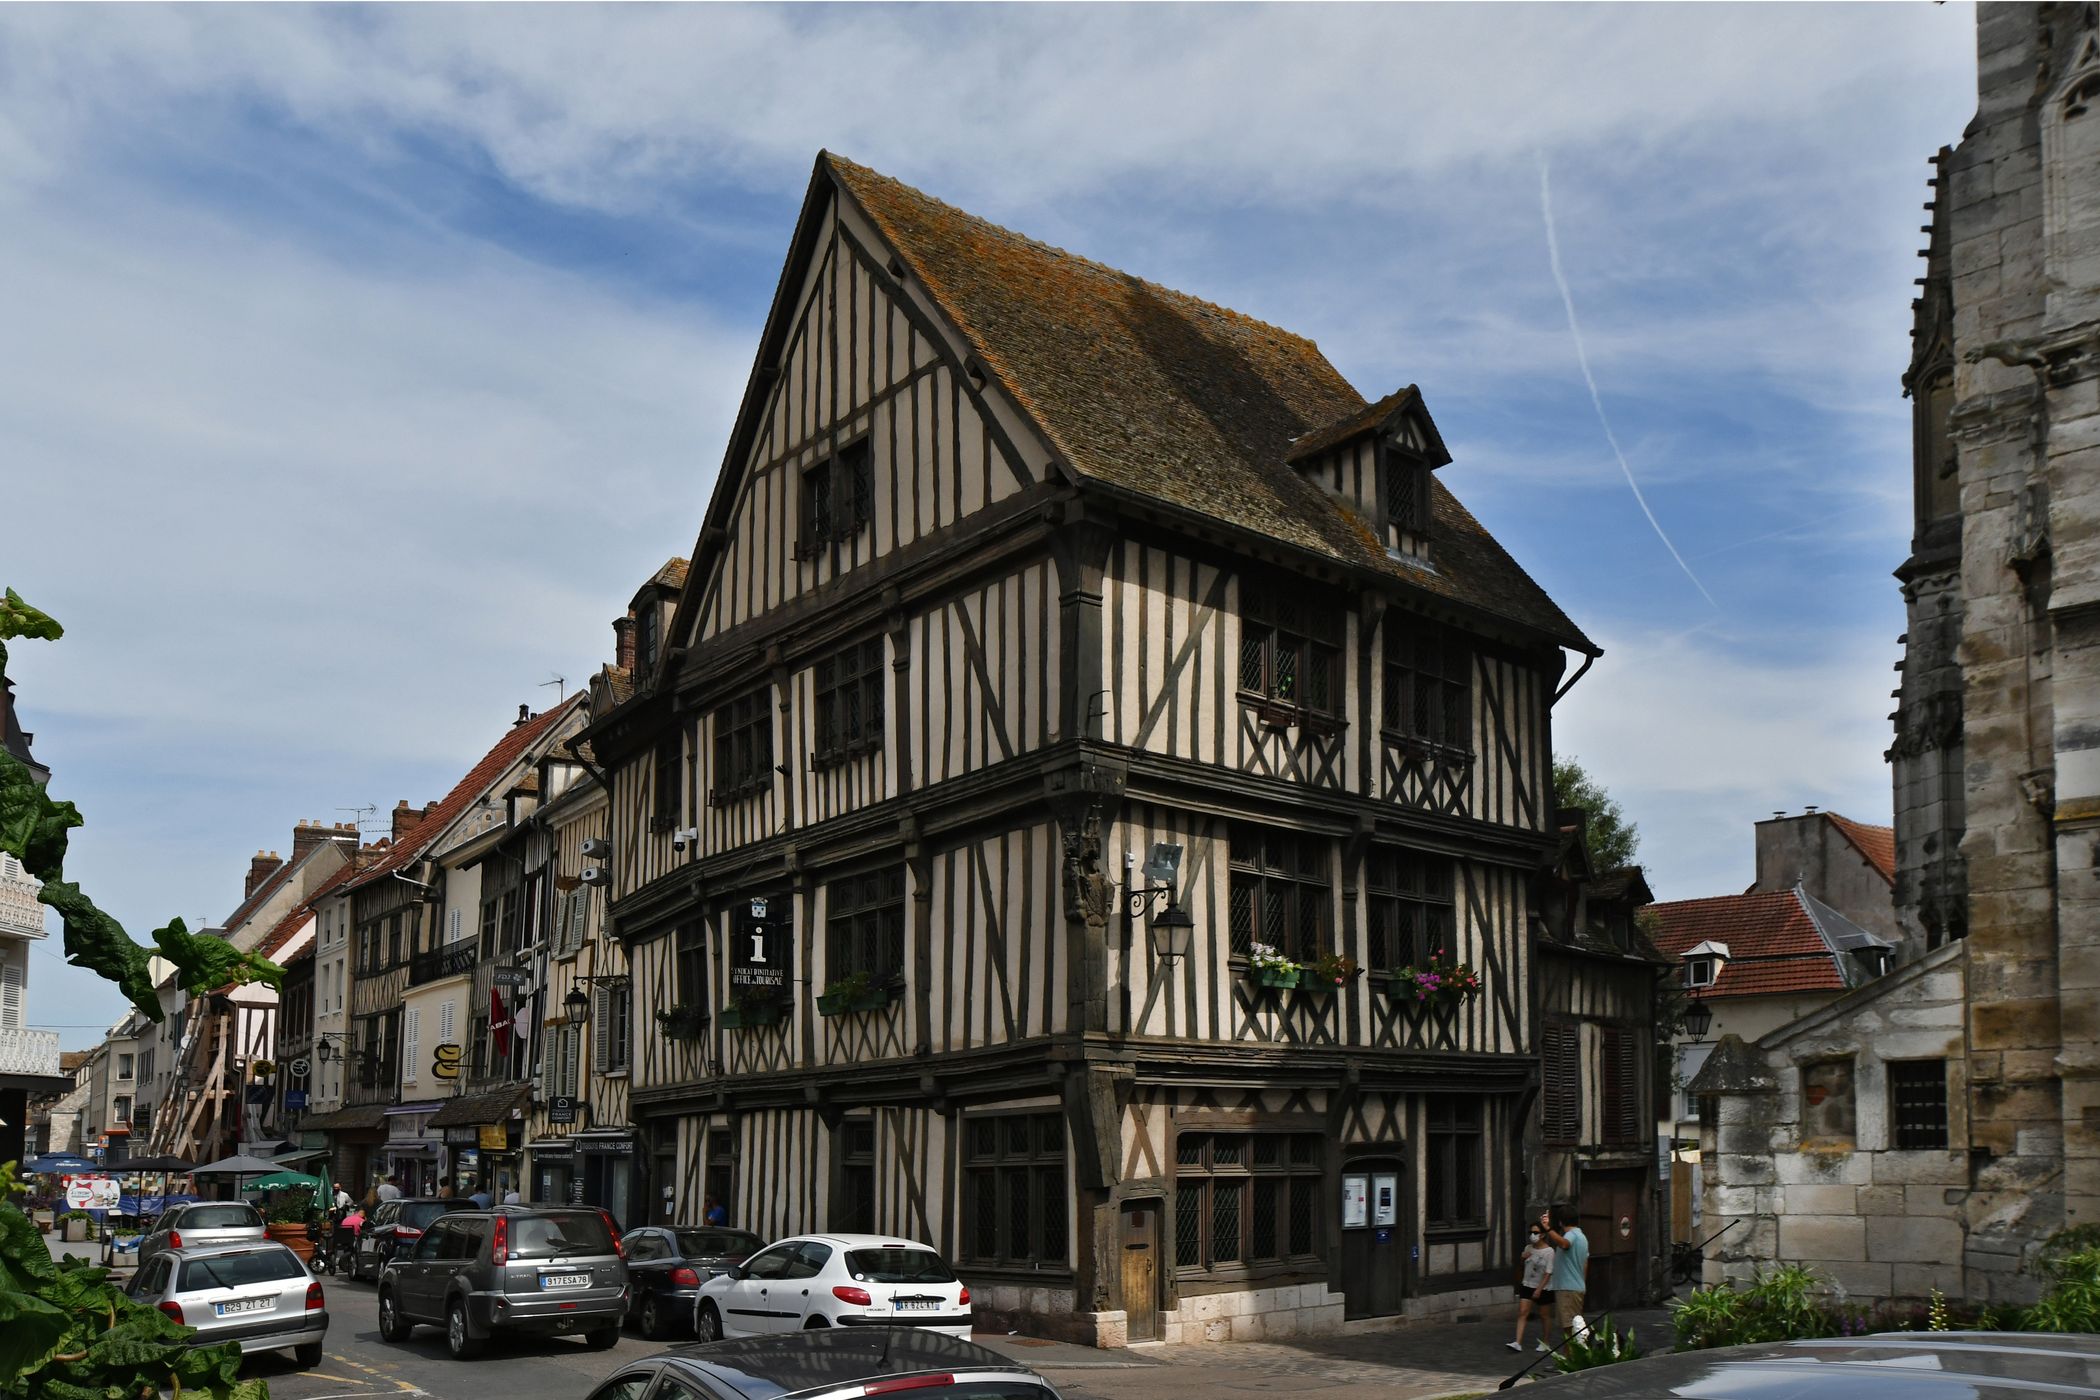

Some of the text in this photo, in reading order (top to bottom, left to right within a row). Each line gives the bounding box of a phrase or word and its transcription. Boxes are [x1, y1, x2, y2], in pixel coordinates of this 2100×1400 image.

[750, 927, 766, 962] i
[733, 975, 751, 984] OFFICE
[756, 976, 782, 985] TOURISME
[599, 1141, 616, 1150] FRANCE
[616, 1141, 633, 1150] CONFORT
[224, 1299, 271, 1313] 629 ZT 27
